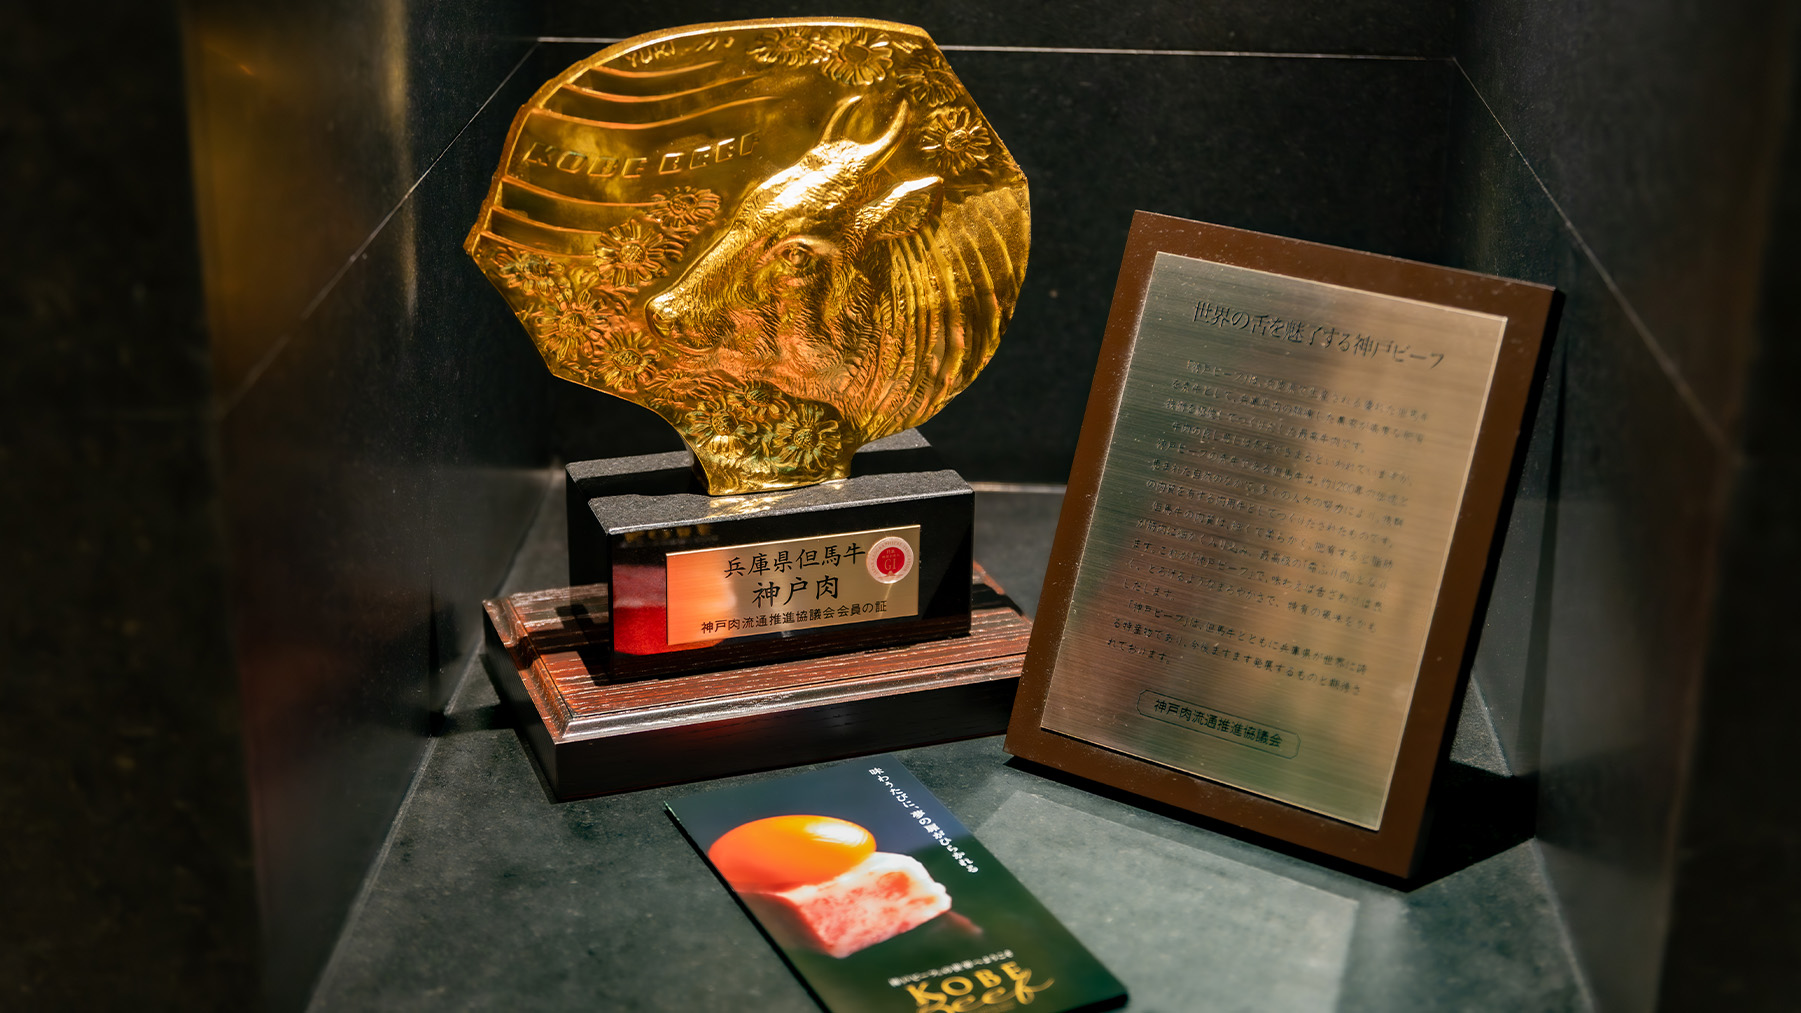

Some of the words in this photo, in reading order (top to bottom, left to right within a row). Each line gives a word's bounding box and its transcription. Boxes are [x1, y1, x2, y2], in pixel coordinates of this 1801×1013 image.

[523, 142, 648, 179] KOBE
[658, 130, 760, 175] BEEF
[1190, 298, 1447, 371] 世界の舌を魅了する神戸ビーフ
[724, 542, 866, 578] 兵庫県但馬牛
[884, 558, 897, 570] GI
[752, 575, 839, 608] 神戸肉
[700, 600, 888, 635] 神戸肉流通推進協議会会員の証
[1152, 697, 1284, 749] 神戸肉流通推進協議会
[905, 960, 1027, 1005] KOBE
